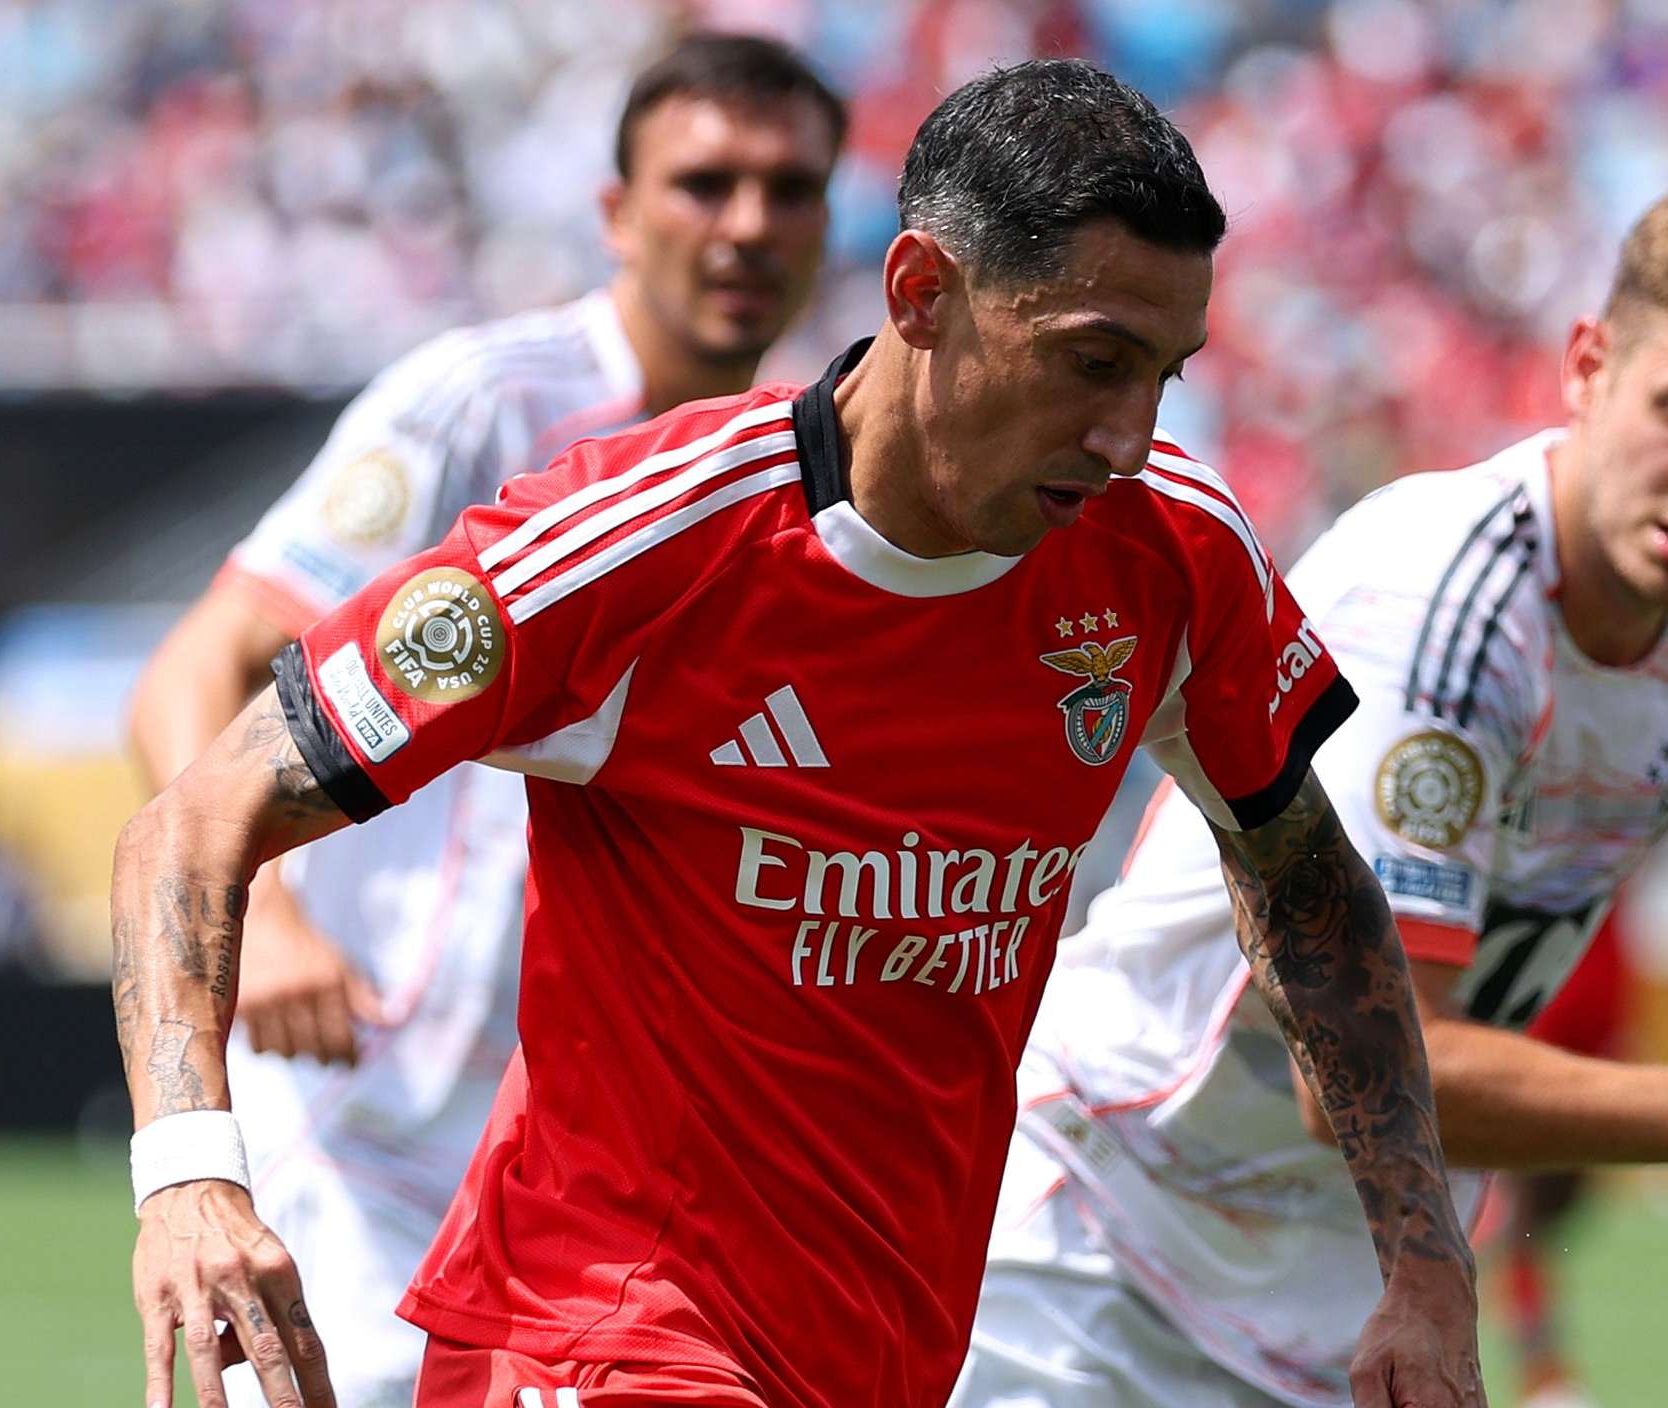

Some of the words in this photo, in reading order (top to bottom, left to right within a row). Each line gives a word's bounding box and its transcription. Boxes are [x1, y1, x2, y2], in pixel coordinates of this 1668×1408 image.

[392, 590, 424, 628] CLUB
[427, 581, 480, 611] WORLD
[477, 615, 493, 650] CUP
[385, 639, 424, 689] FIFA
[436, 671, 473, 690] USA
[472, 653, 489, 675] 25
[358, 719, 381, 748] FIFA
[365, 697, 398, 736] UNITES
[210, 921, 236, 998] Rosario
[791, 920, 879, 986] FLY
[879, 916, 1031, 995] BETTER
